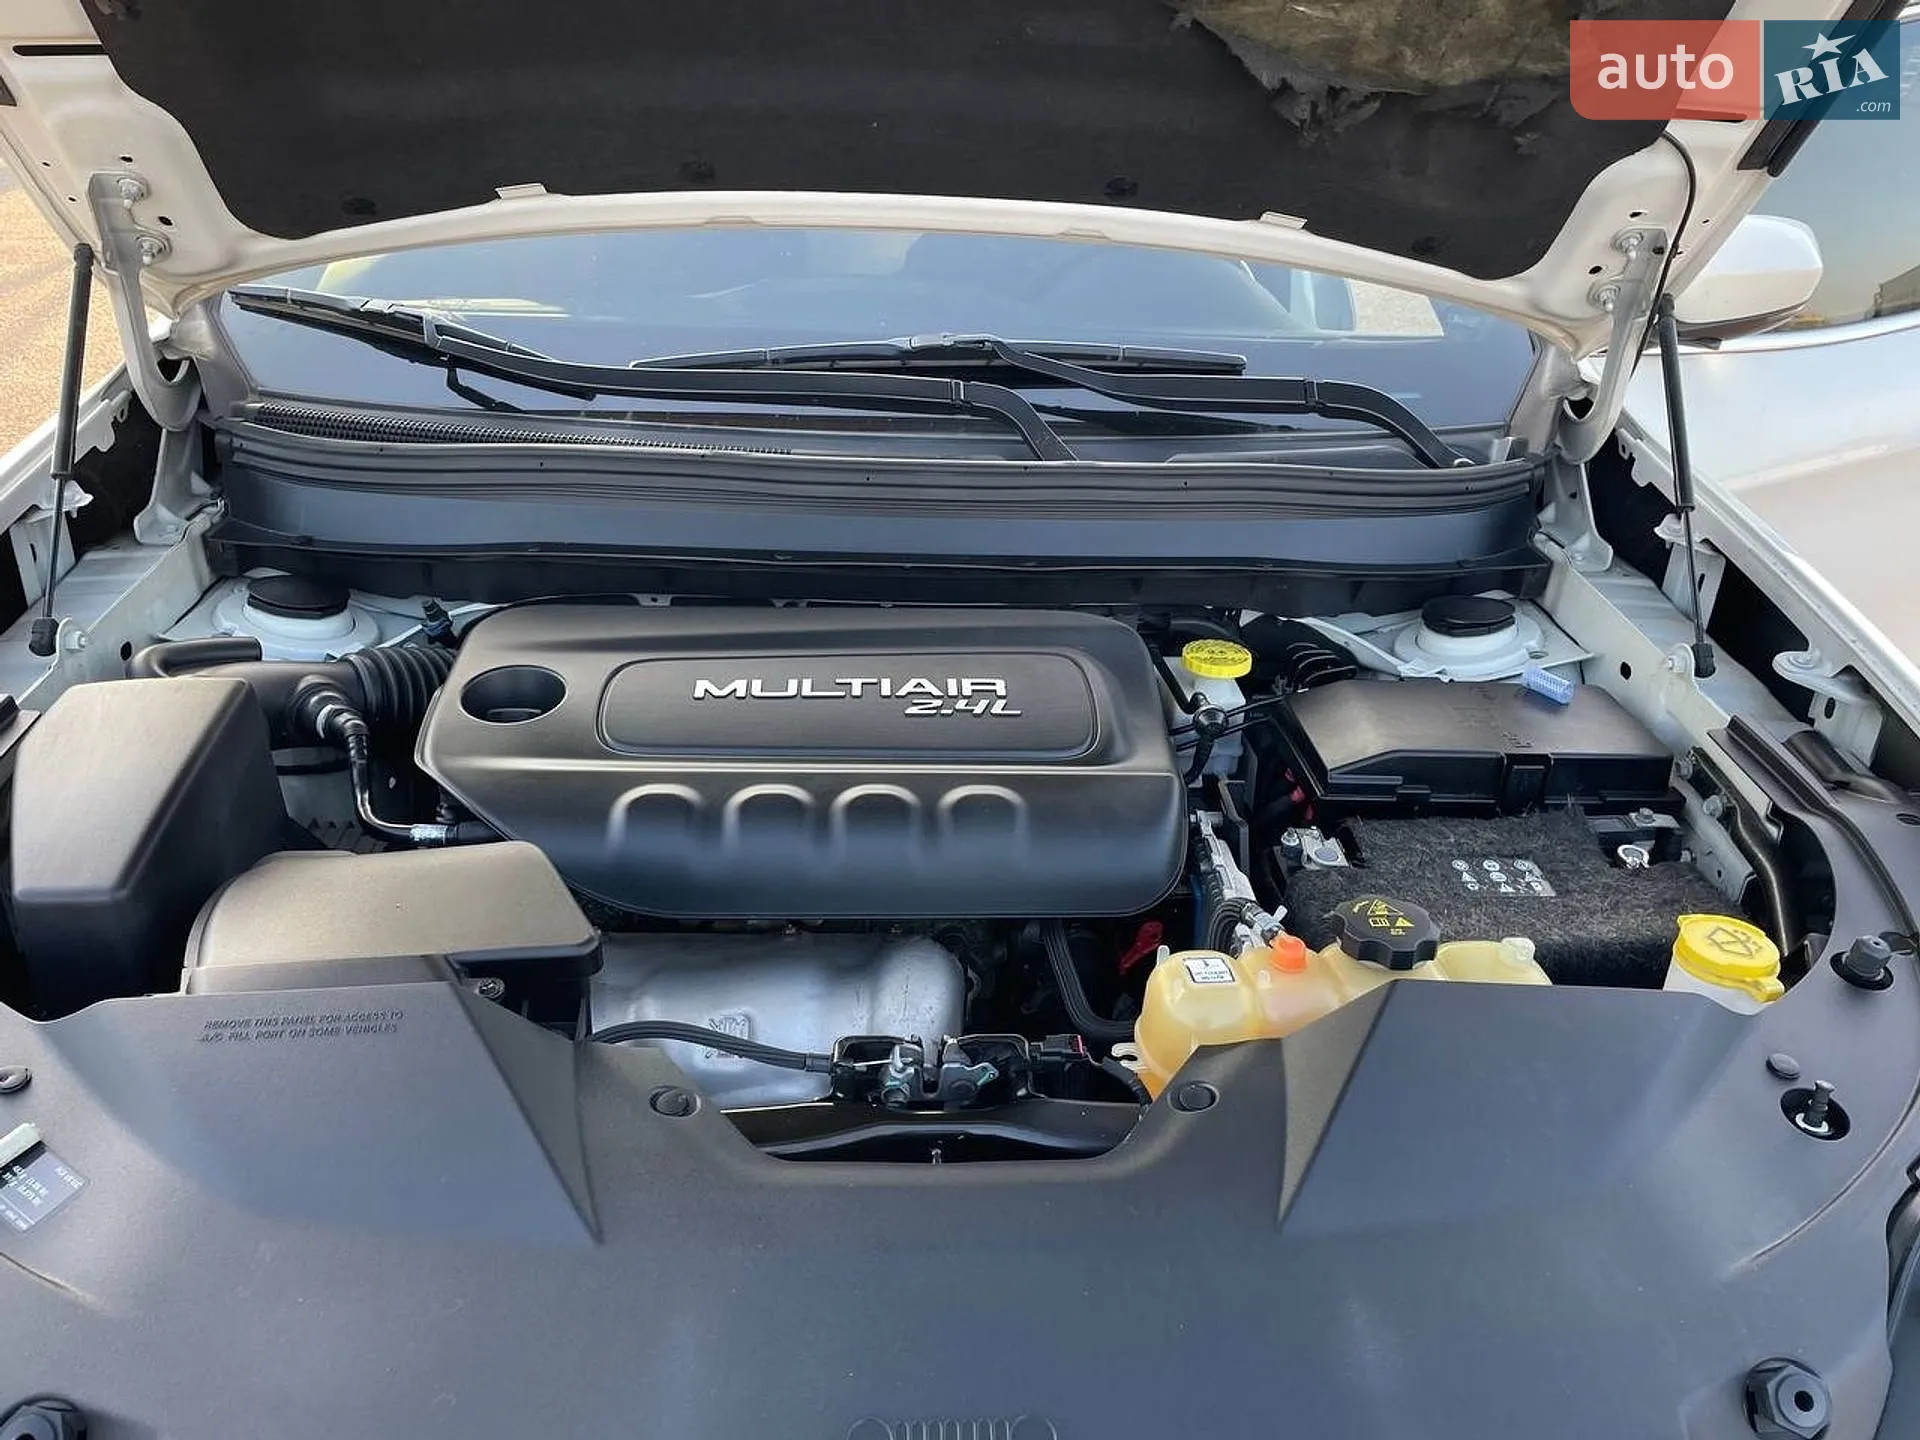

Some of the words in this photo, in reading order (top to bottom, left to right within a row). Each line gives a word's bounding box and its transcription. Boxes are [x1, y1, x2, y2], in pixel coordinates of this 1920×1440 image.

[693, 678, 1007, 698] MULTIAIR
[904, 699, 1022, 716] 2.4L
[204, 1018, 251, 1030] REMOVE
[253, 1017, 278, 1027] THIS
[319, 1013, 341, 1024] FOR
[343, 1011, 387, 1022] ACCESS
[255, 1029, 285, 1040] PORT
[309, 1025, 341, 1037] SOME
